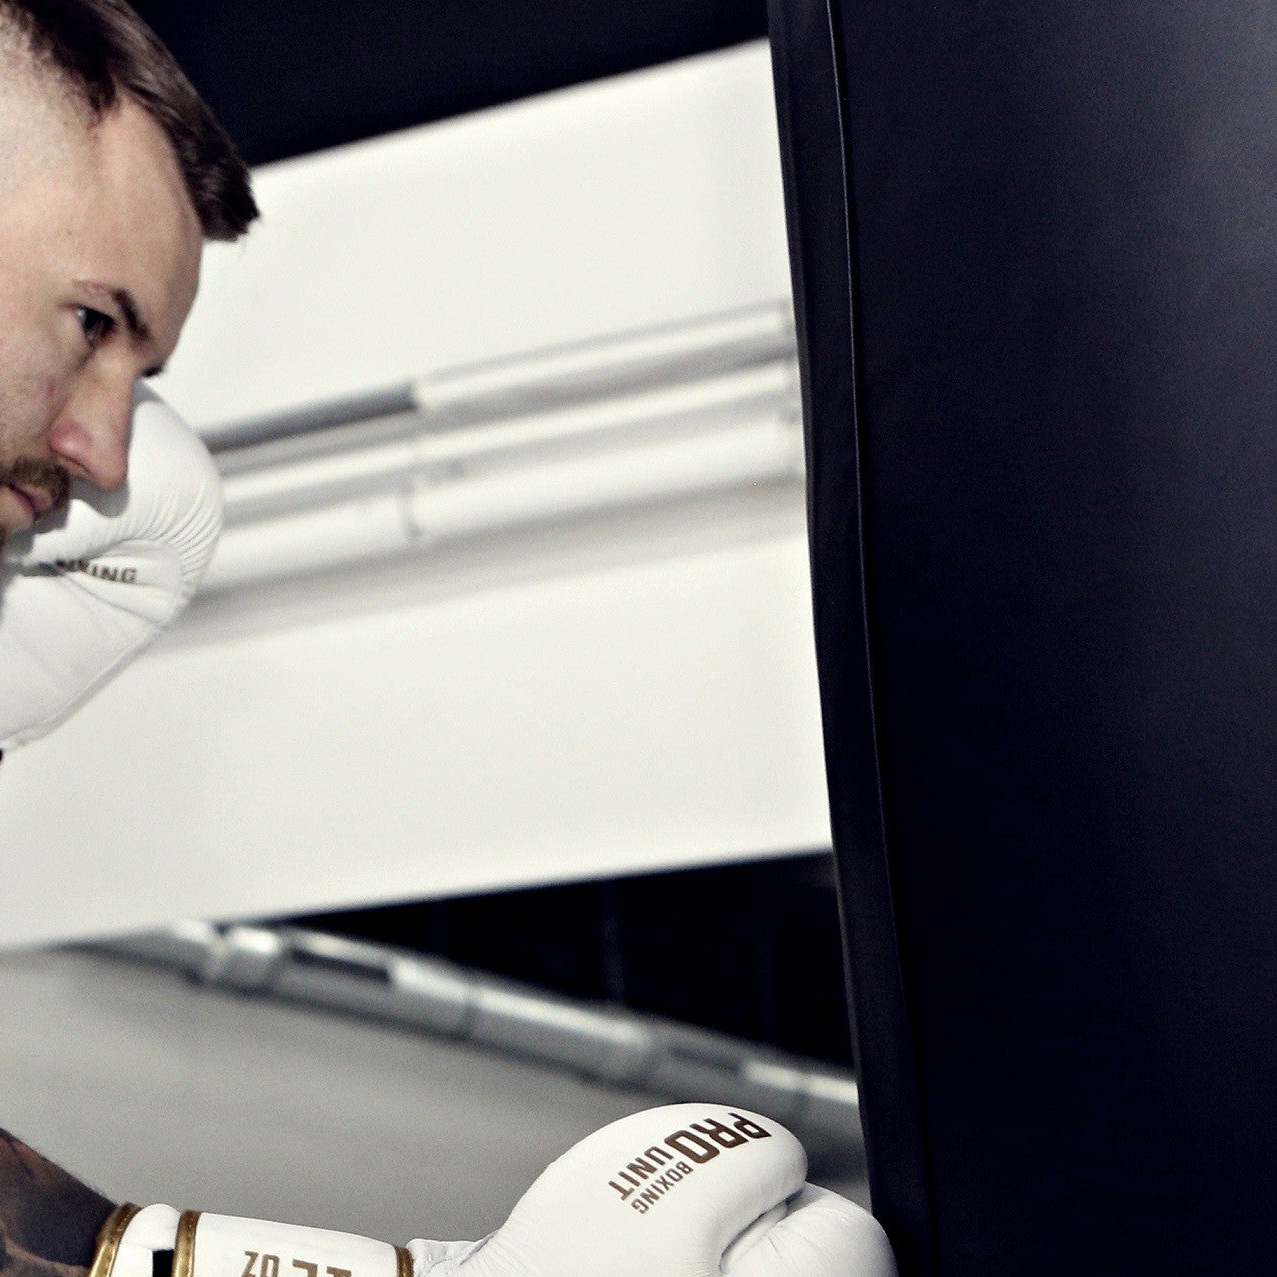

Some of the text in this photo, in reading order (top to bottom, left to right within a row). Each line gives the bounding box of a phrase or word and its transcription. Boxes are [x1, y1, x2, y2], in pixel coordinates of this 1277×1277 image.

[664, 1112, 773, 1165] PRO
[608, 1146, 674, 1201] UNIT
[631, 1160, 694, 1214] BOXING
